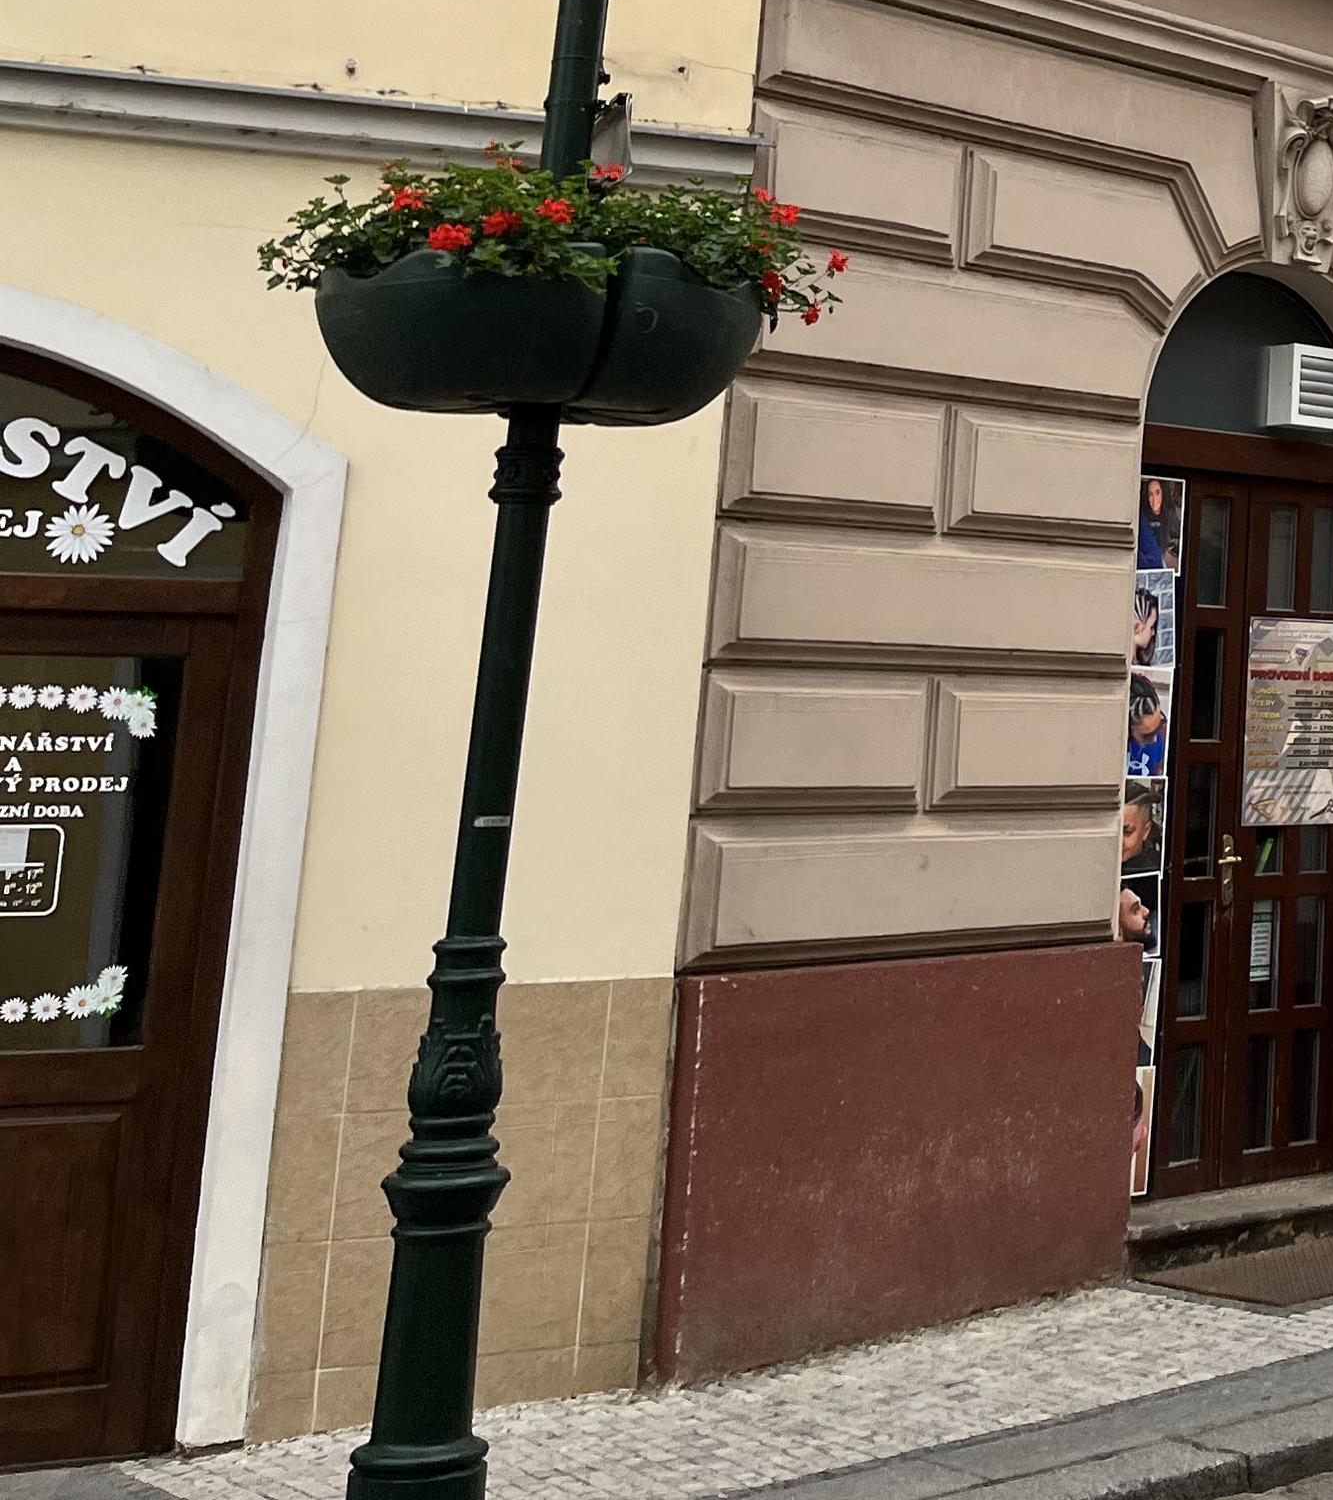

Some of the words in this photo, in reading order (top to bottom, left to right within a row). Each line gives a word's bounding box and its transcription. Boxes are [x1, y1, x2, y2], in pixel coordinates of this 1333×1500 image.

[3, 756, 23, 772] A
[29, 776, 129, 793] PRODEJ
[33, 805, 84, 818] DOBA
